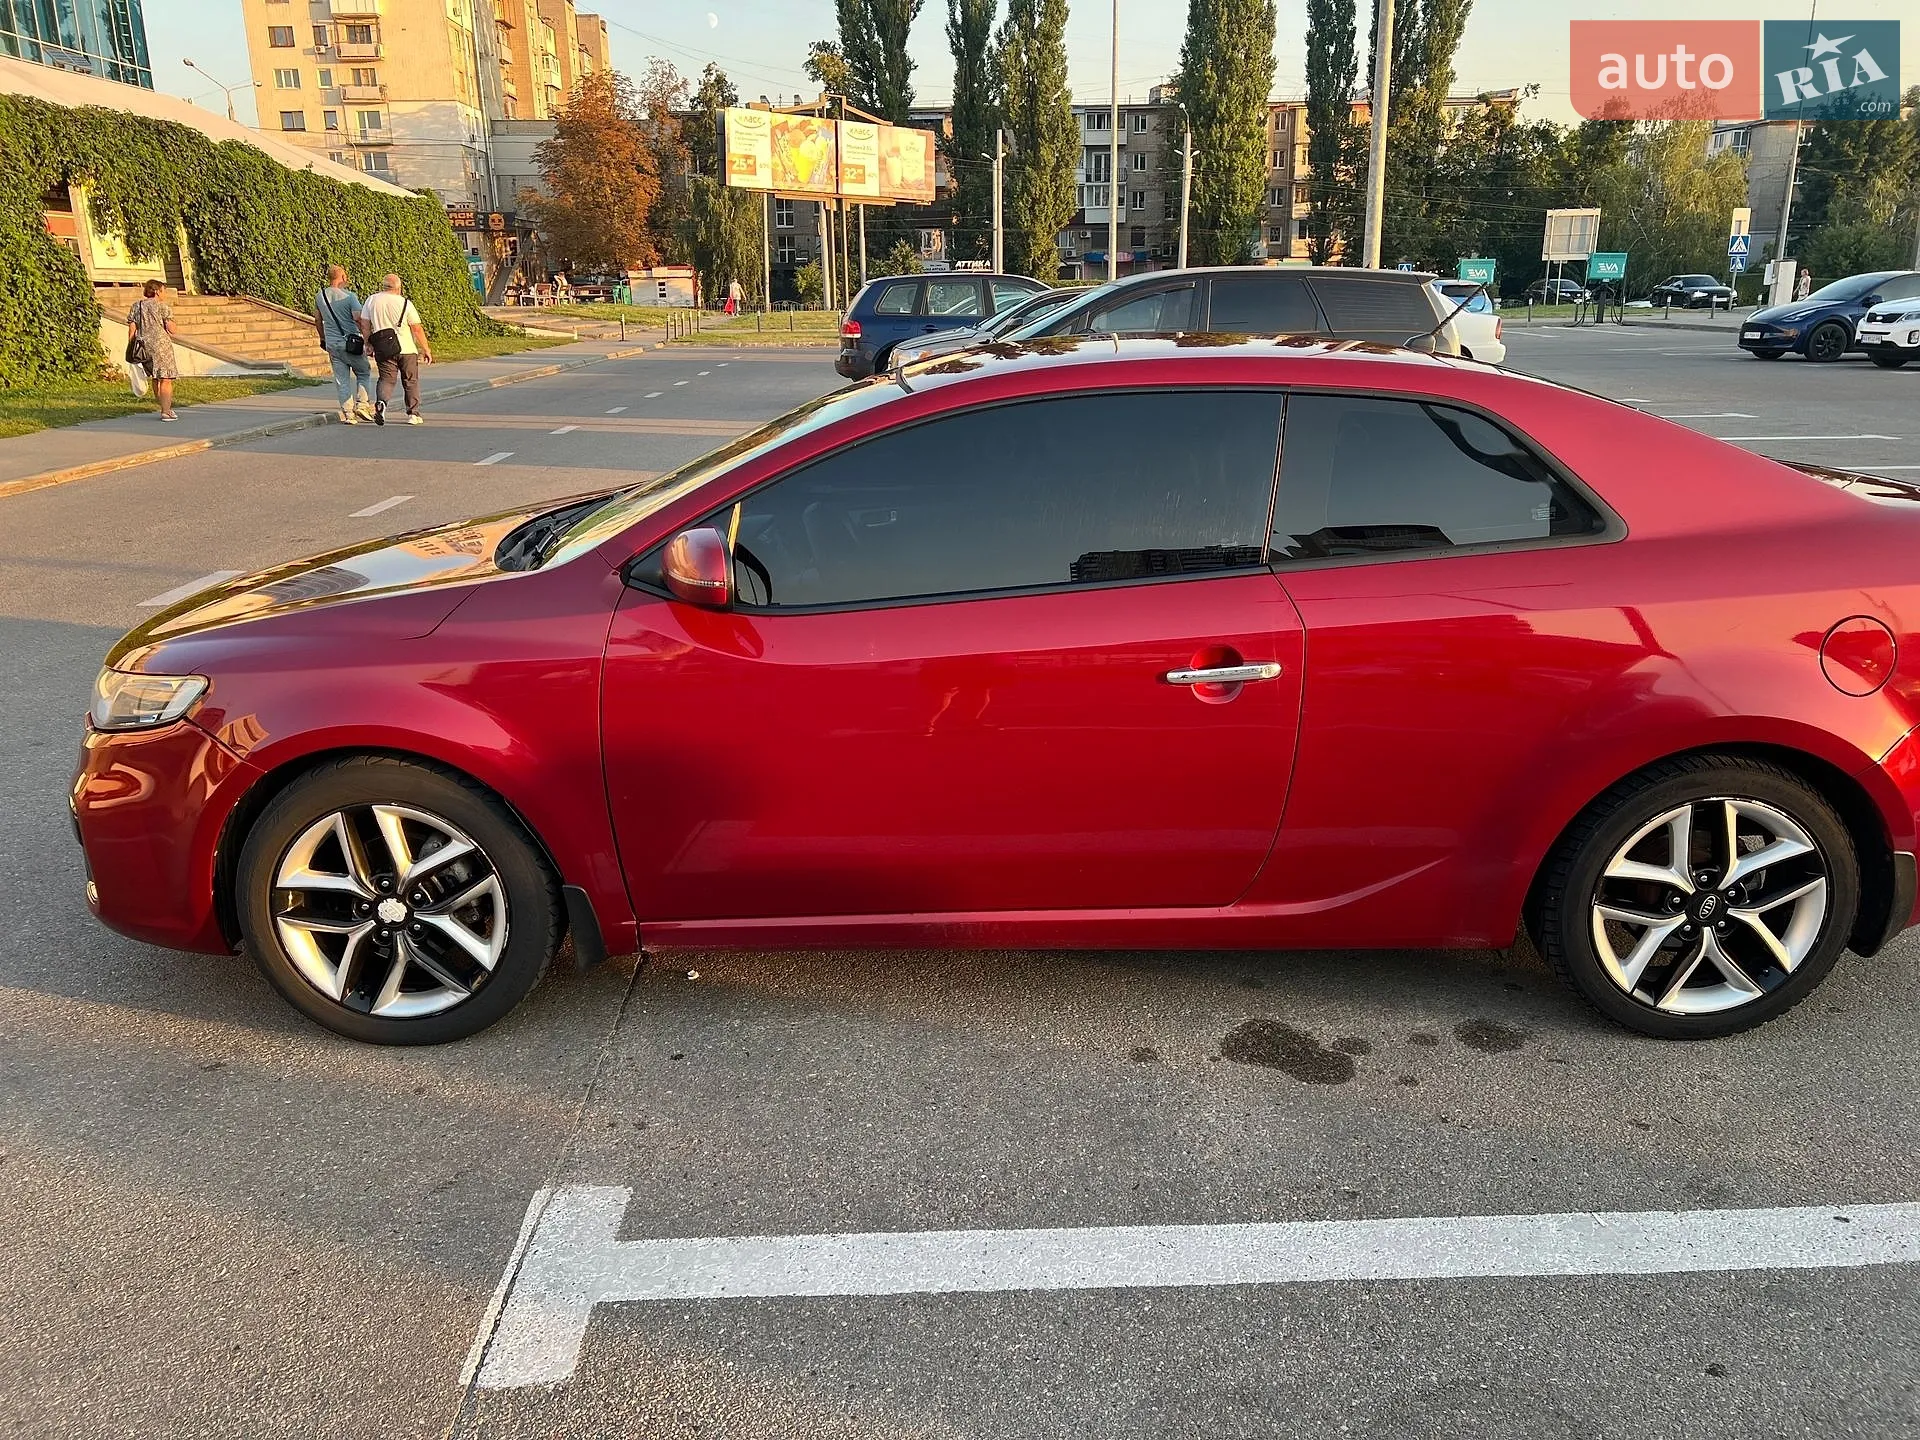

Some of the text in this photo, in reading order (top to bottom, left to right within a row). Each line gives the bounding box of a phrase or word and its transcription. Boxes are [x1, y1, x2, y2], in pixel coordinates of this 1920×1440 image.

[955, 259, 991, 268] АТТИКА
[1598, 262, 1619, 271] EVA
[1467, 268, 1488, 277] EVA
